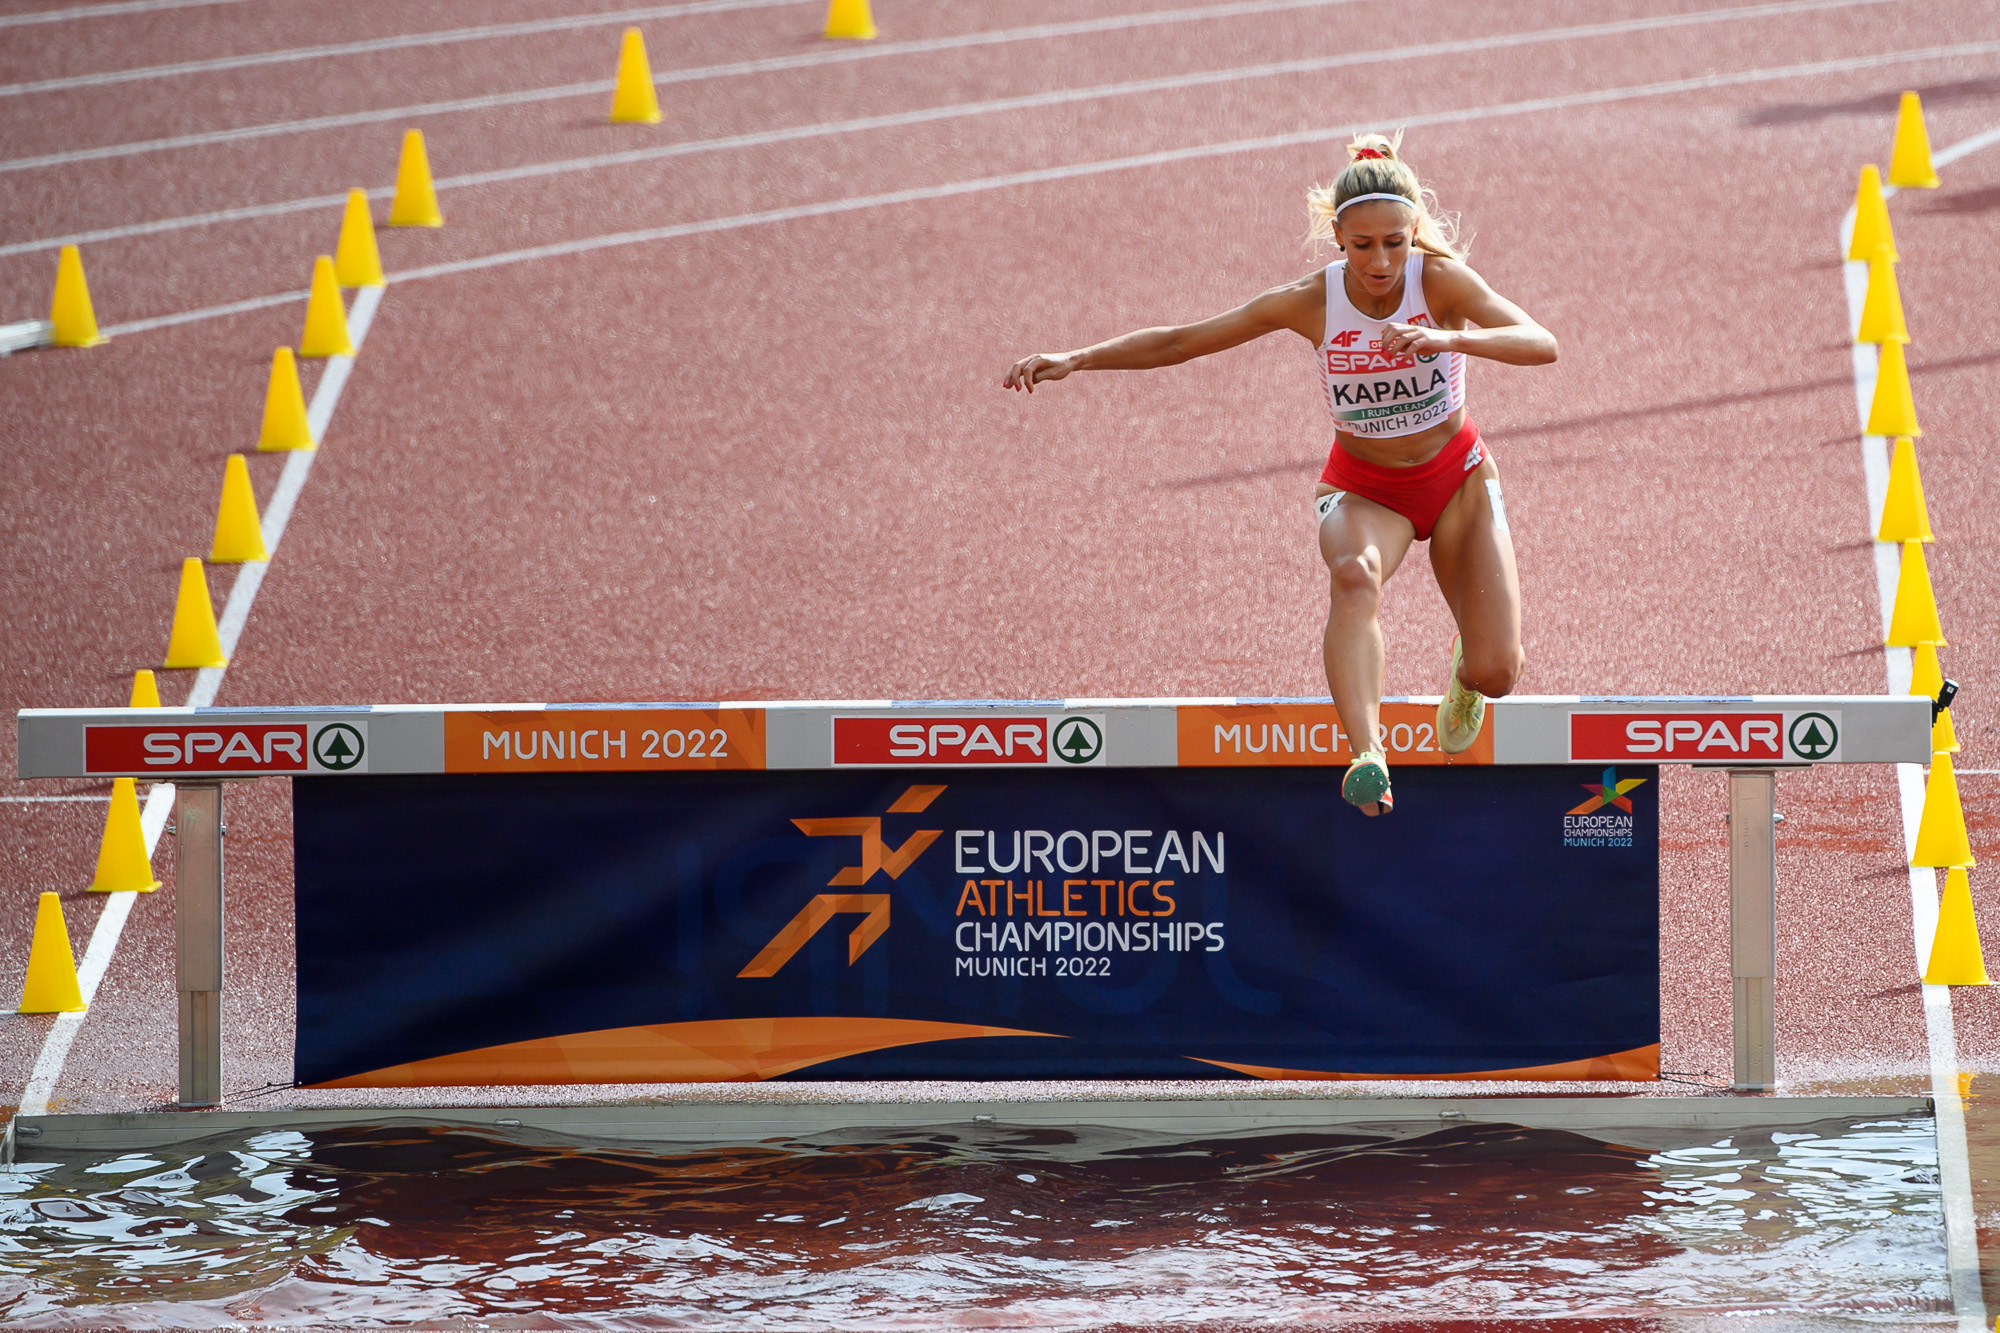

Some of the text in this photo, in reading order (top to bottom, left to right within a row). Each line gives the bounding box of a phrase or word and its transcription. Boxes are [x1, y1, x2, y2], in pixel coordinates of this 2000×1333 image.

[1331, 330, 1362, 347] 4F
[1332, 368, 1446, 406] KAPALA
[1361, 410, 1366, 419] I
[1367, 405, 1390, 417] RUN
[1413, 400, 1448, 425] 2022
[144, 731, 302, 765] SPAR
[483, 728, 728, 760] MUNICH 2022
[889, 724, 1043, 757] SPAR
[1625, 720, 1779, 753] SPAR
[1563, 815, 1633, 828] EUROPEAN
[1563, 828, 1633, 838] CHAMPIONSHIPS
[955, 829, 1225, 874] EUROPEAN
[1563, 837, 1633, 847] MUNICH 2022
[955, 879, 1176, 917] ATHLETICS
[955, 921, 1225, 952] CHAMPIONSHIPS
[955, 956, 1111, 977] MUNICH 2022
